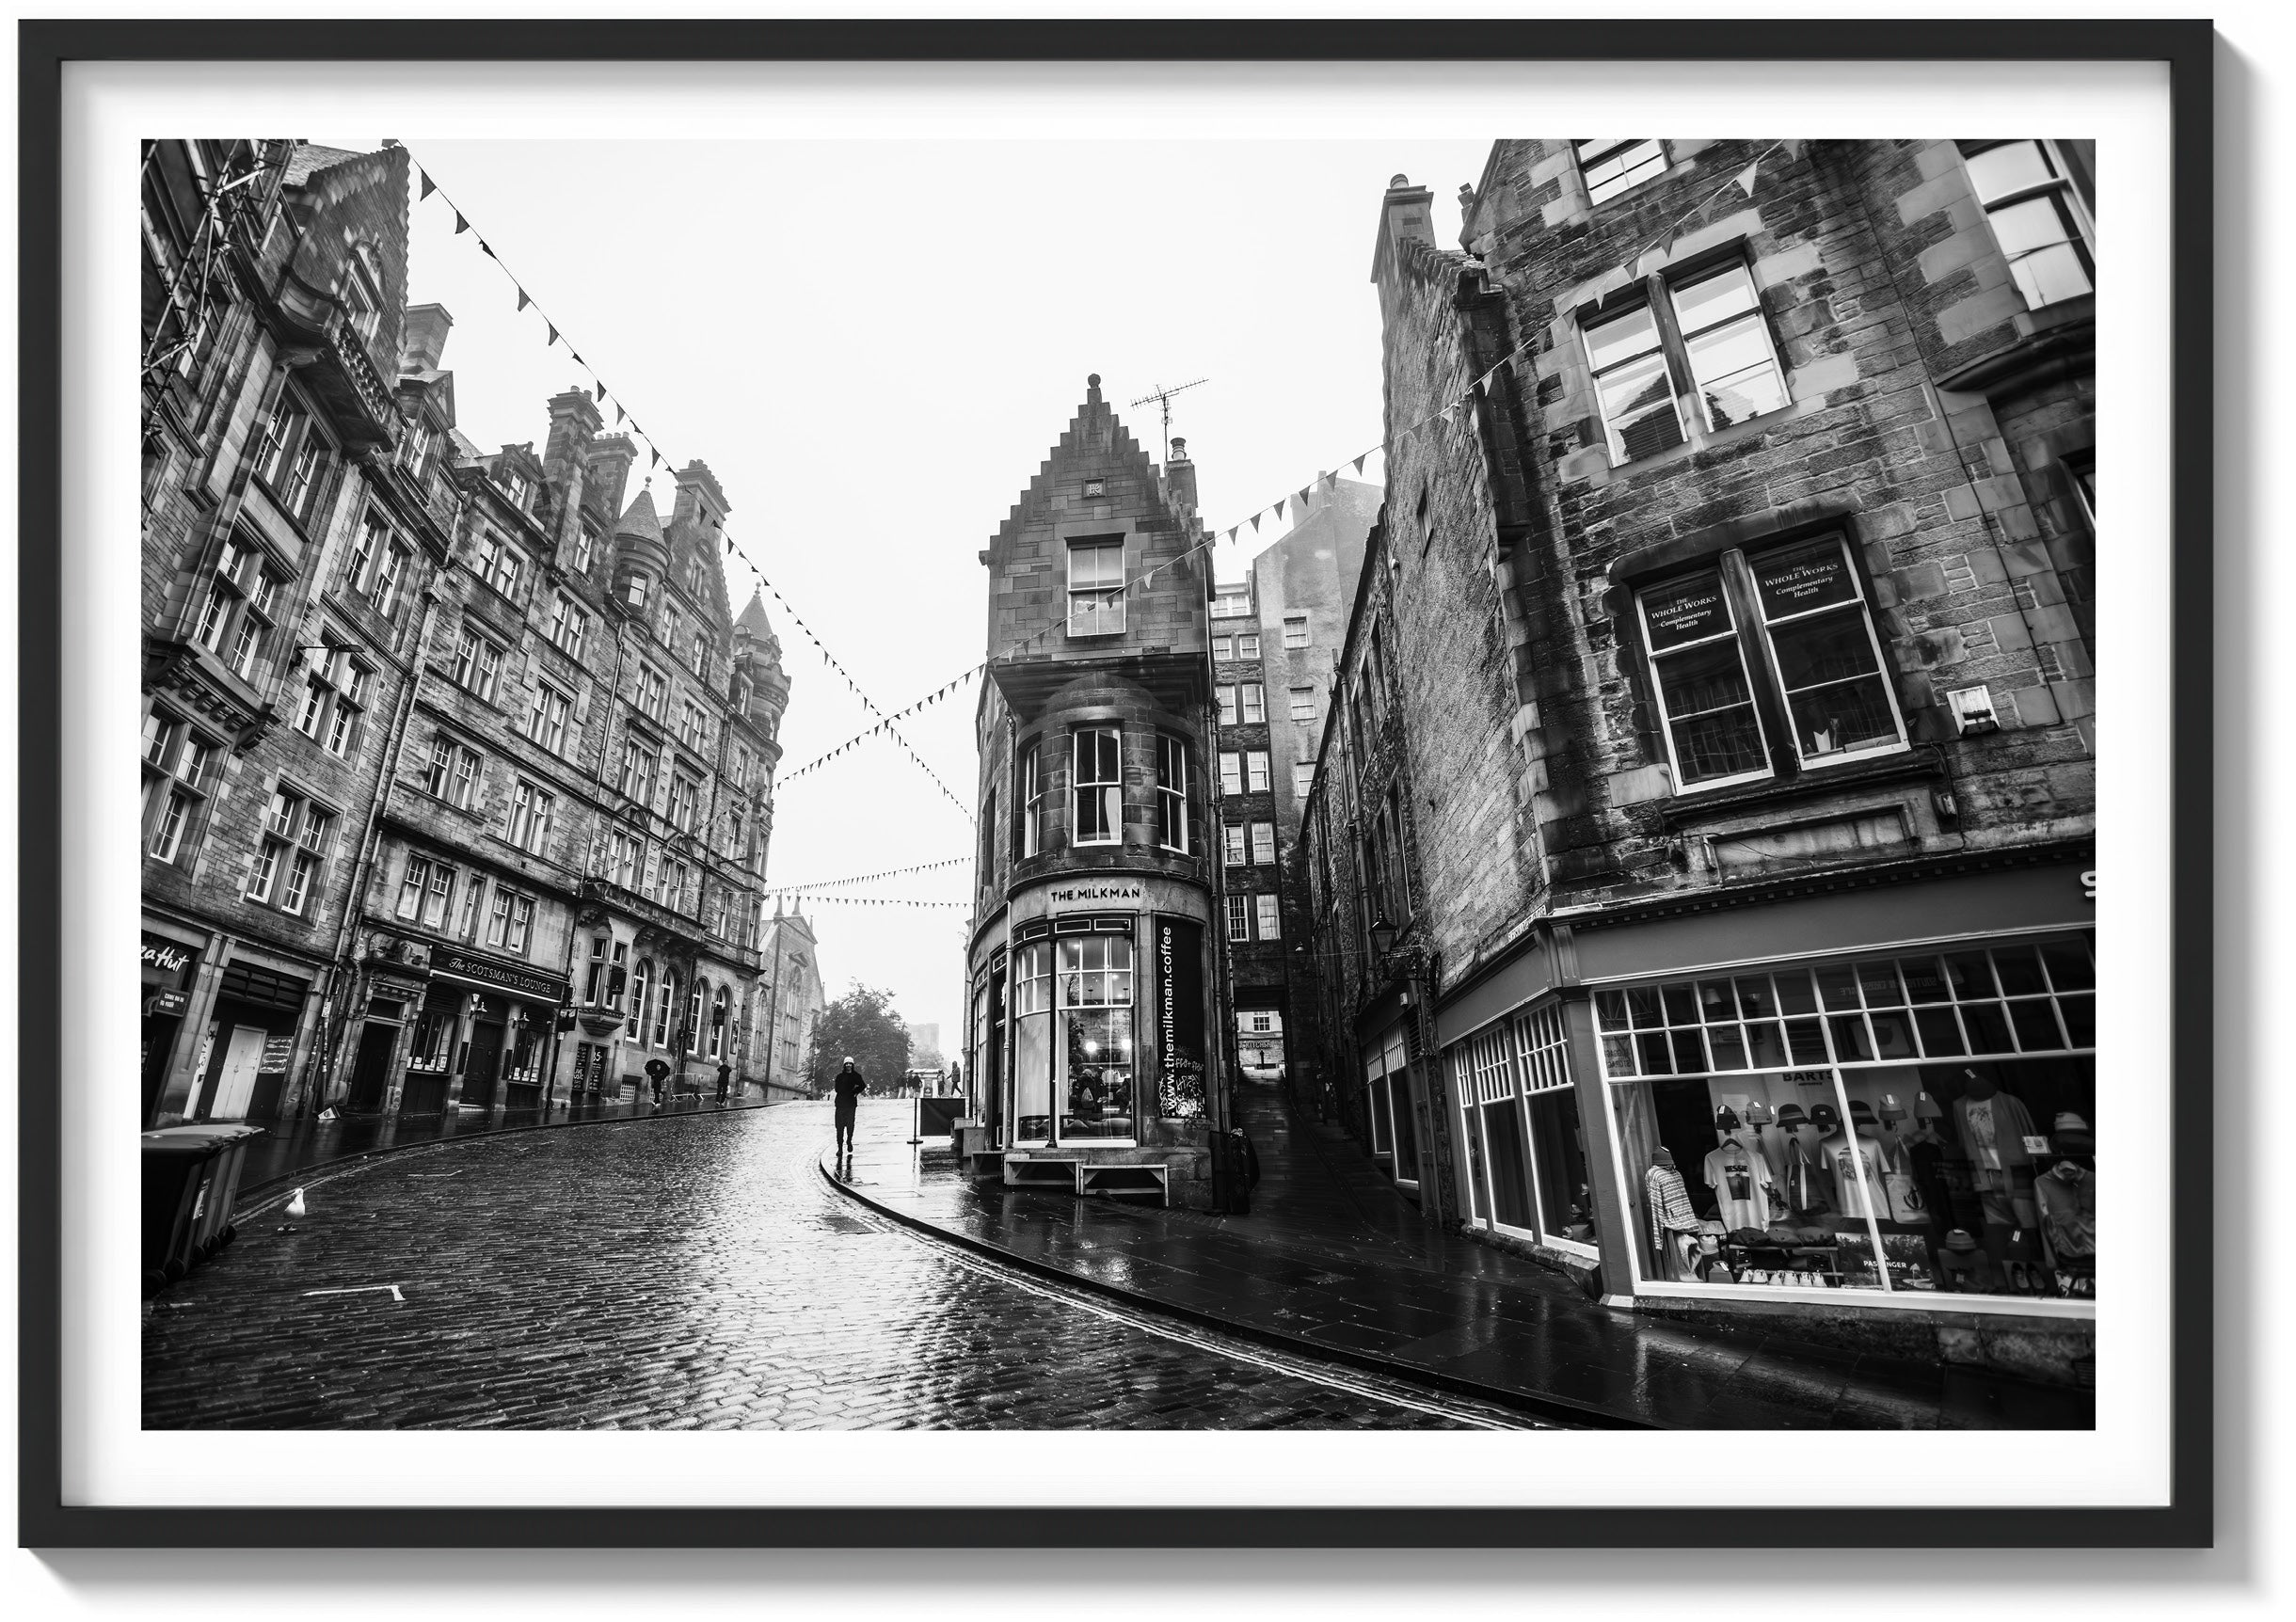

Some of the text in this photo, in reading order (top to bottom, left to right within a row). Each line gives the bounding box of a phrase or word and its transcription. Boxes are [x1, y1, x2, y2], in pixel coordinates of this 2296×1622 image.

[1764, 563, 1839, 587] WHOLE WORKS
[1776, 576, 1833, 596] Complementary
[1794, 586, 1819, 598] Health
[1651, 595, 1717, 619] WHOLE WORKS
[1660, 610, 1712, 628] Complementary
[1676, 619, 1698, 630] Health
[1051, 887, 1140, 902] THE MILKMAN
[154, 946, 190, 973] Hut
[449, 958, 551, 994] The SCOTSMAN'S LOUNGE
[1160, 926, 1176, 1111] www.themilkman.coffee
